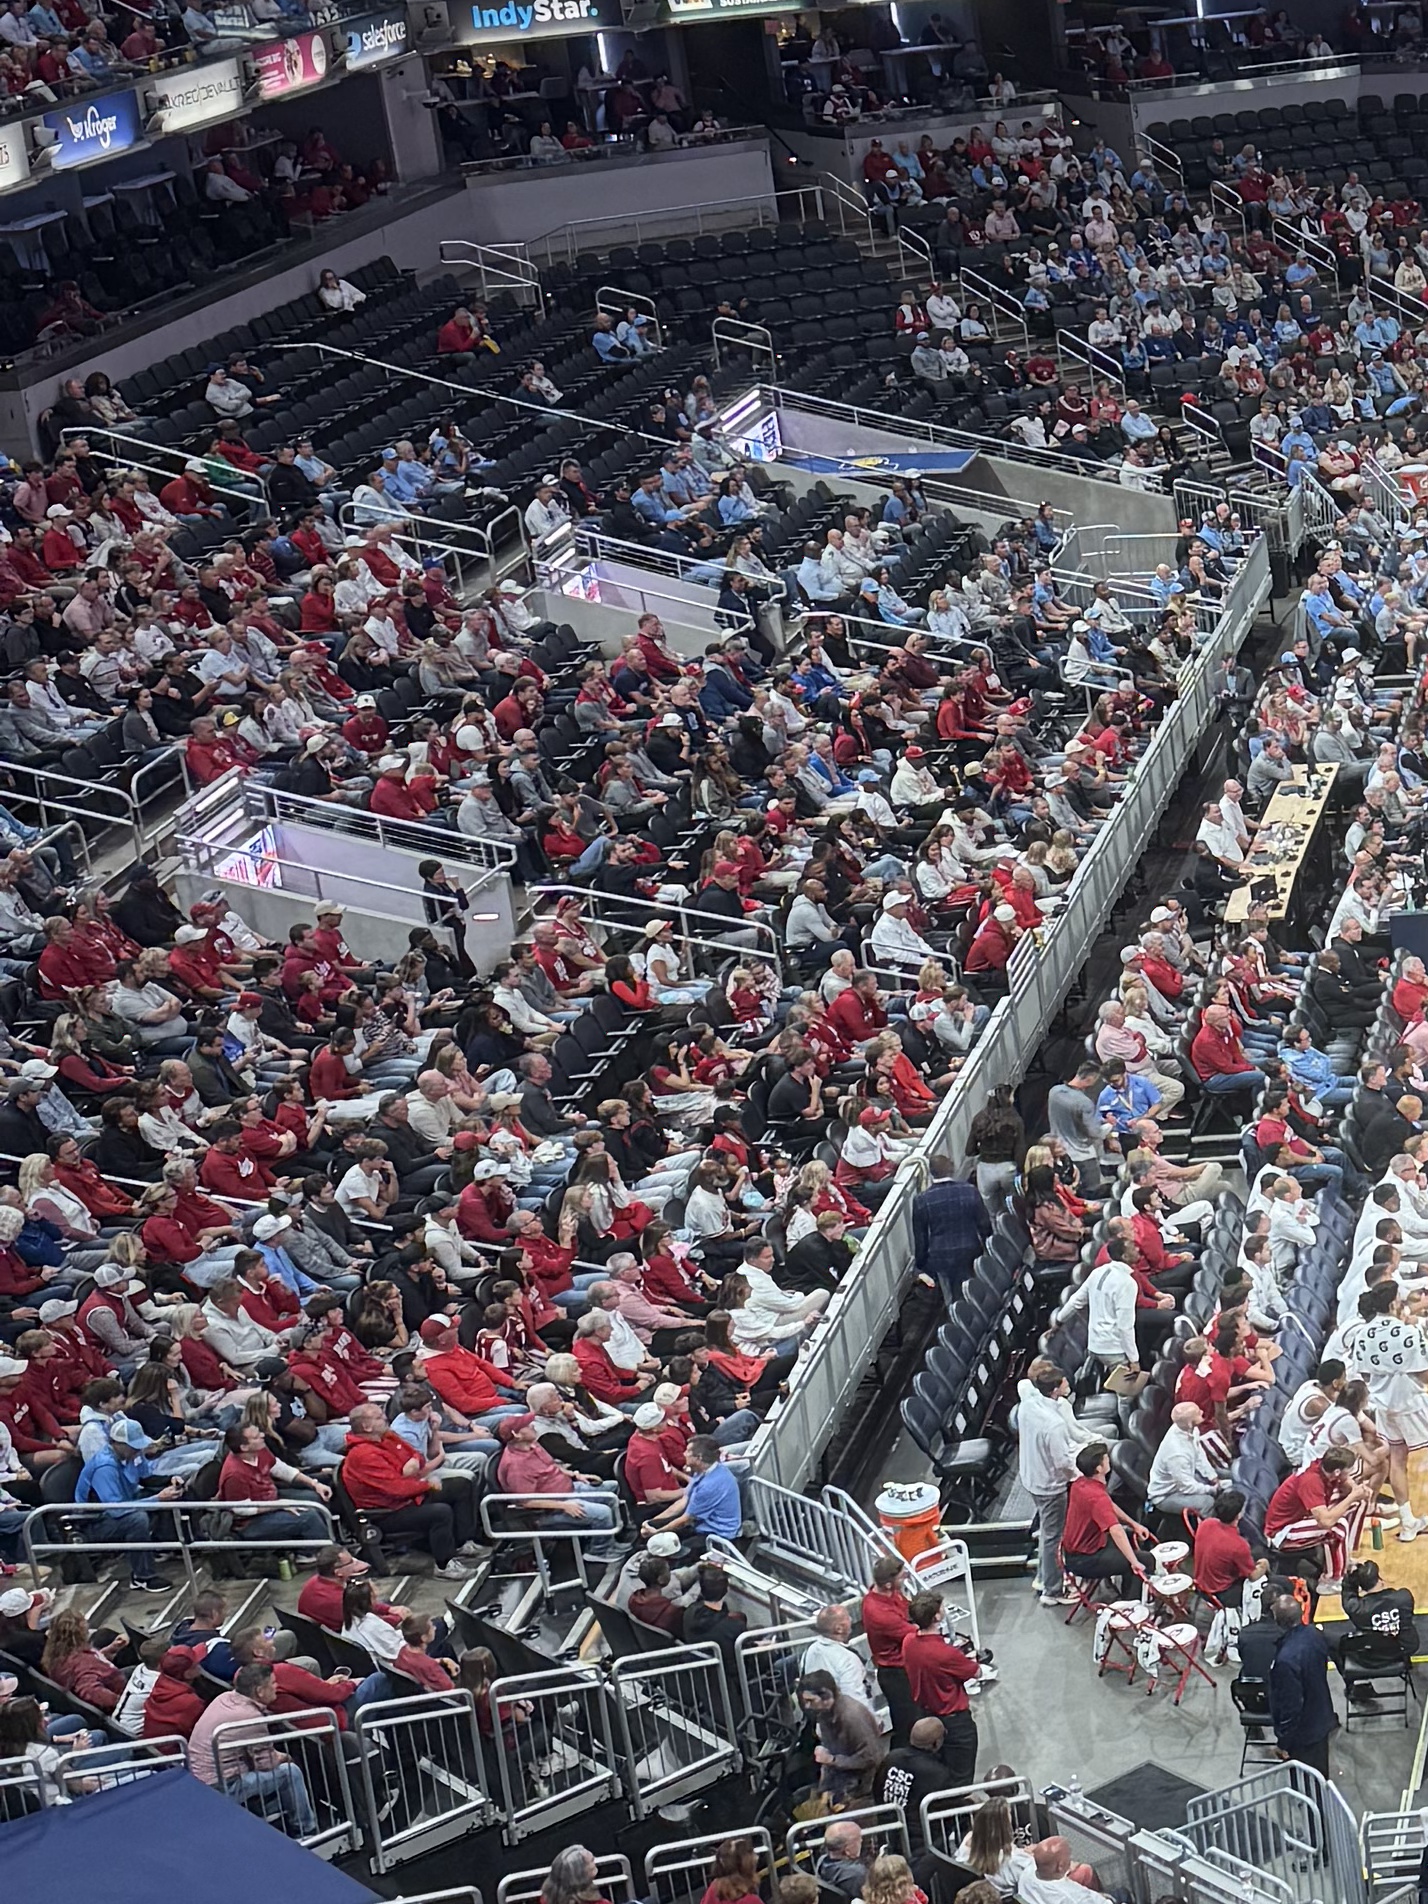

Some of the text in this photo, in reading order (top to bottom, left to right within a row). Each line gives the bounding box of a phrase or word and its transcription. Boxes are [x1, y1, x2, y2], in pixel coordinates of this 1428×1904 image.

[362, 18, 407, 52] salesforce
[84, 105, 117, 149] Kroger
[1371, 1608, 1400, 1627] CSC
[886, 1766, 914, 1787] CSC
